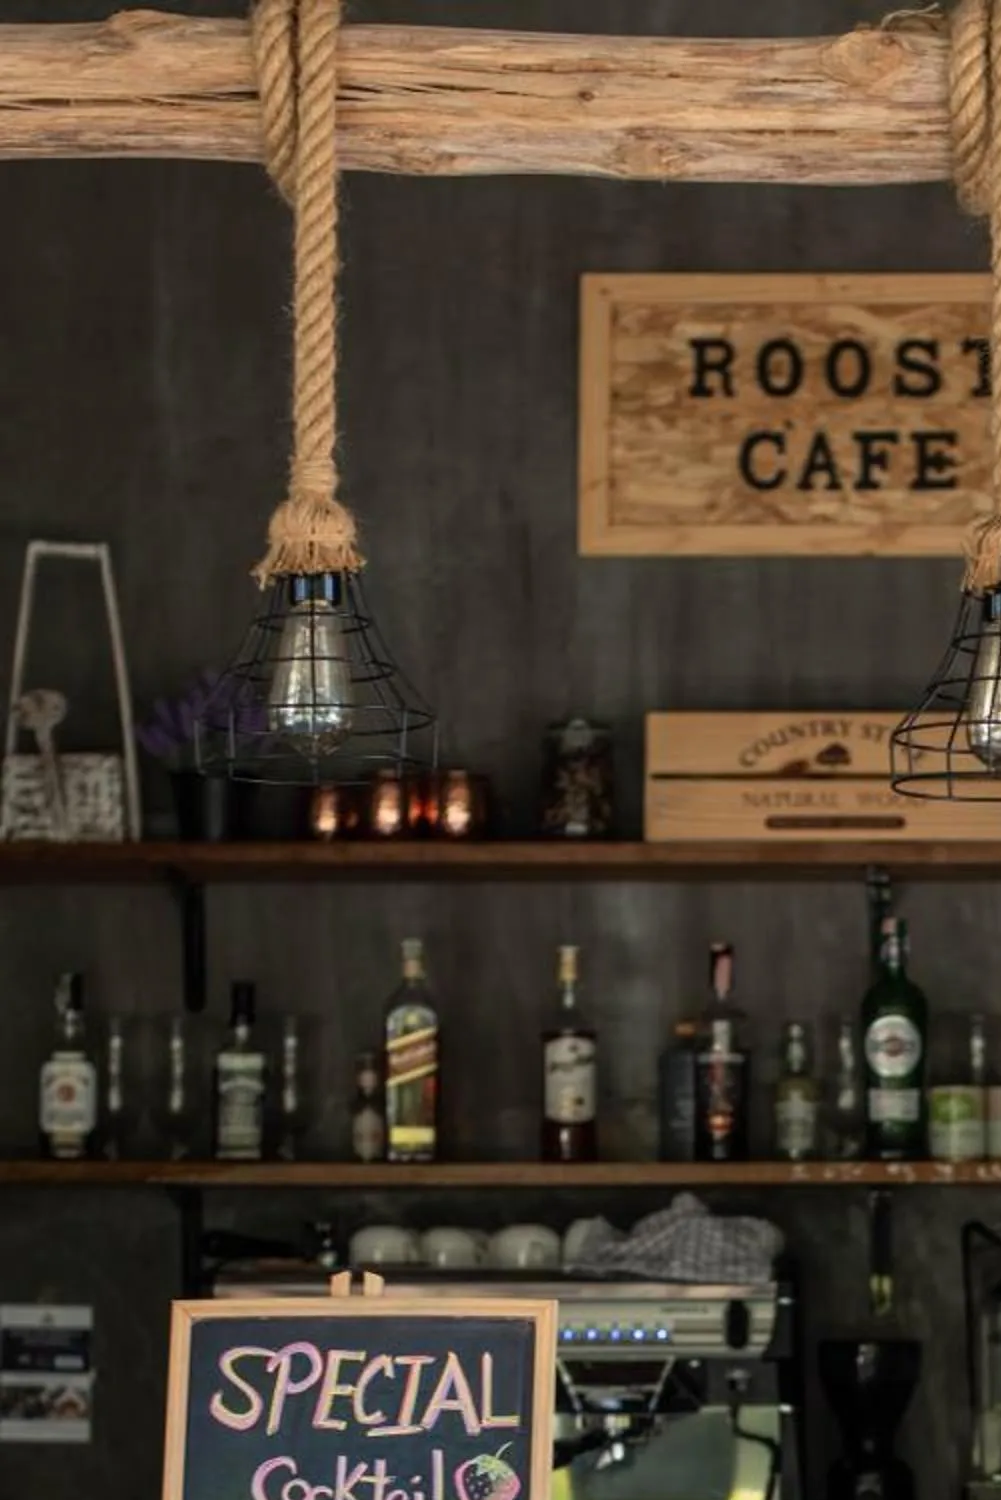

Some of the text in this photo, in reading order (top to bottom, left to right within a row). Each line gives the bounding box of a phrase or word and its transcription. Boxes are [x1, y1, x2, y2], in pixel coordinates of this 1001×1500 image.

[737, 430, 959, 491] CAFE
[738, 718, 851, 768] COUNTRY
[209, 1341, 521, 1436] SPECIAL
